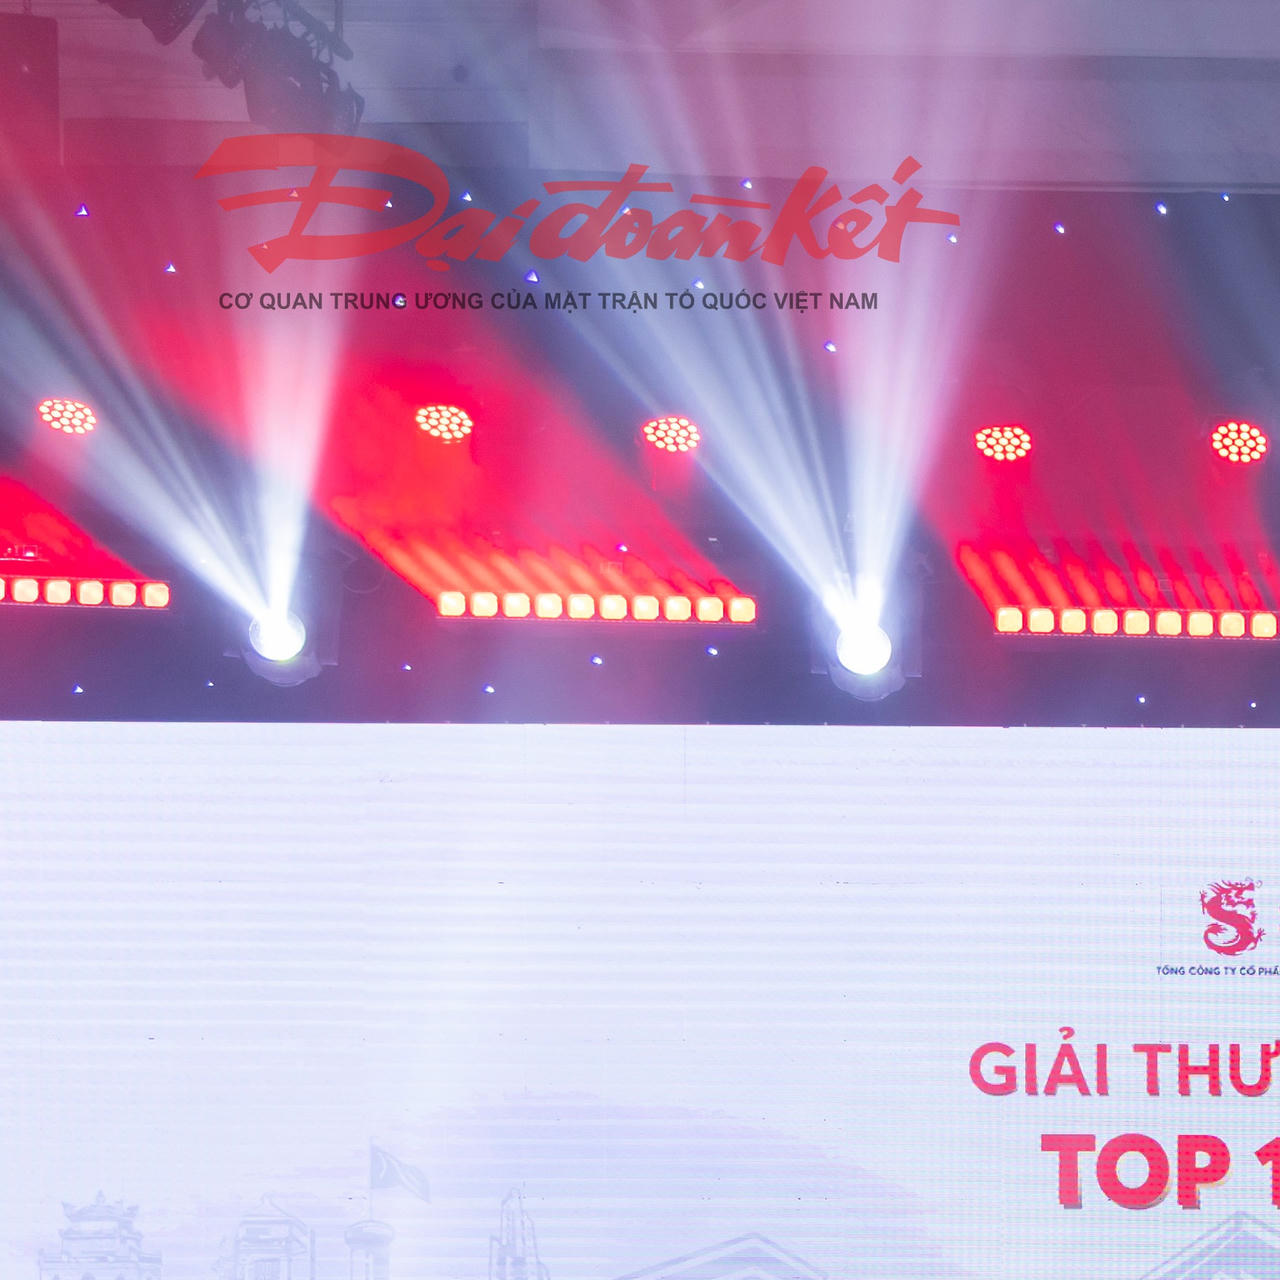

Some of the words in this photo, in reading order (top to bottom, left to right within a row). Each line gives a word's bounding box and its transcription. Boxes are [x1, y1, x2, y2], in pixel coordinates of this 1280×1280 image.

[1188, 964, 1221, 976] CÔNG
[1224, 966, 1237, 976] TY
[968, 1026, 1109, 1096] GIẢI
[1041, 1133, 1232, 1208] TOP
